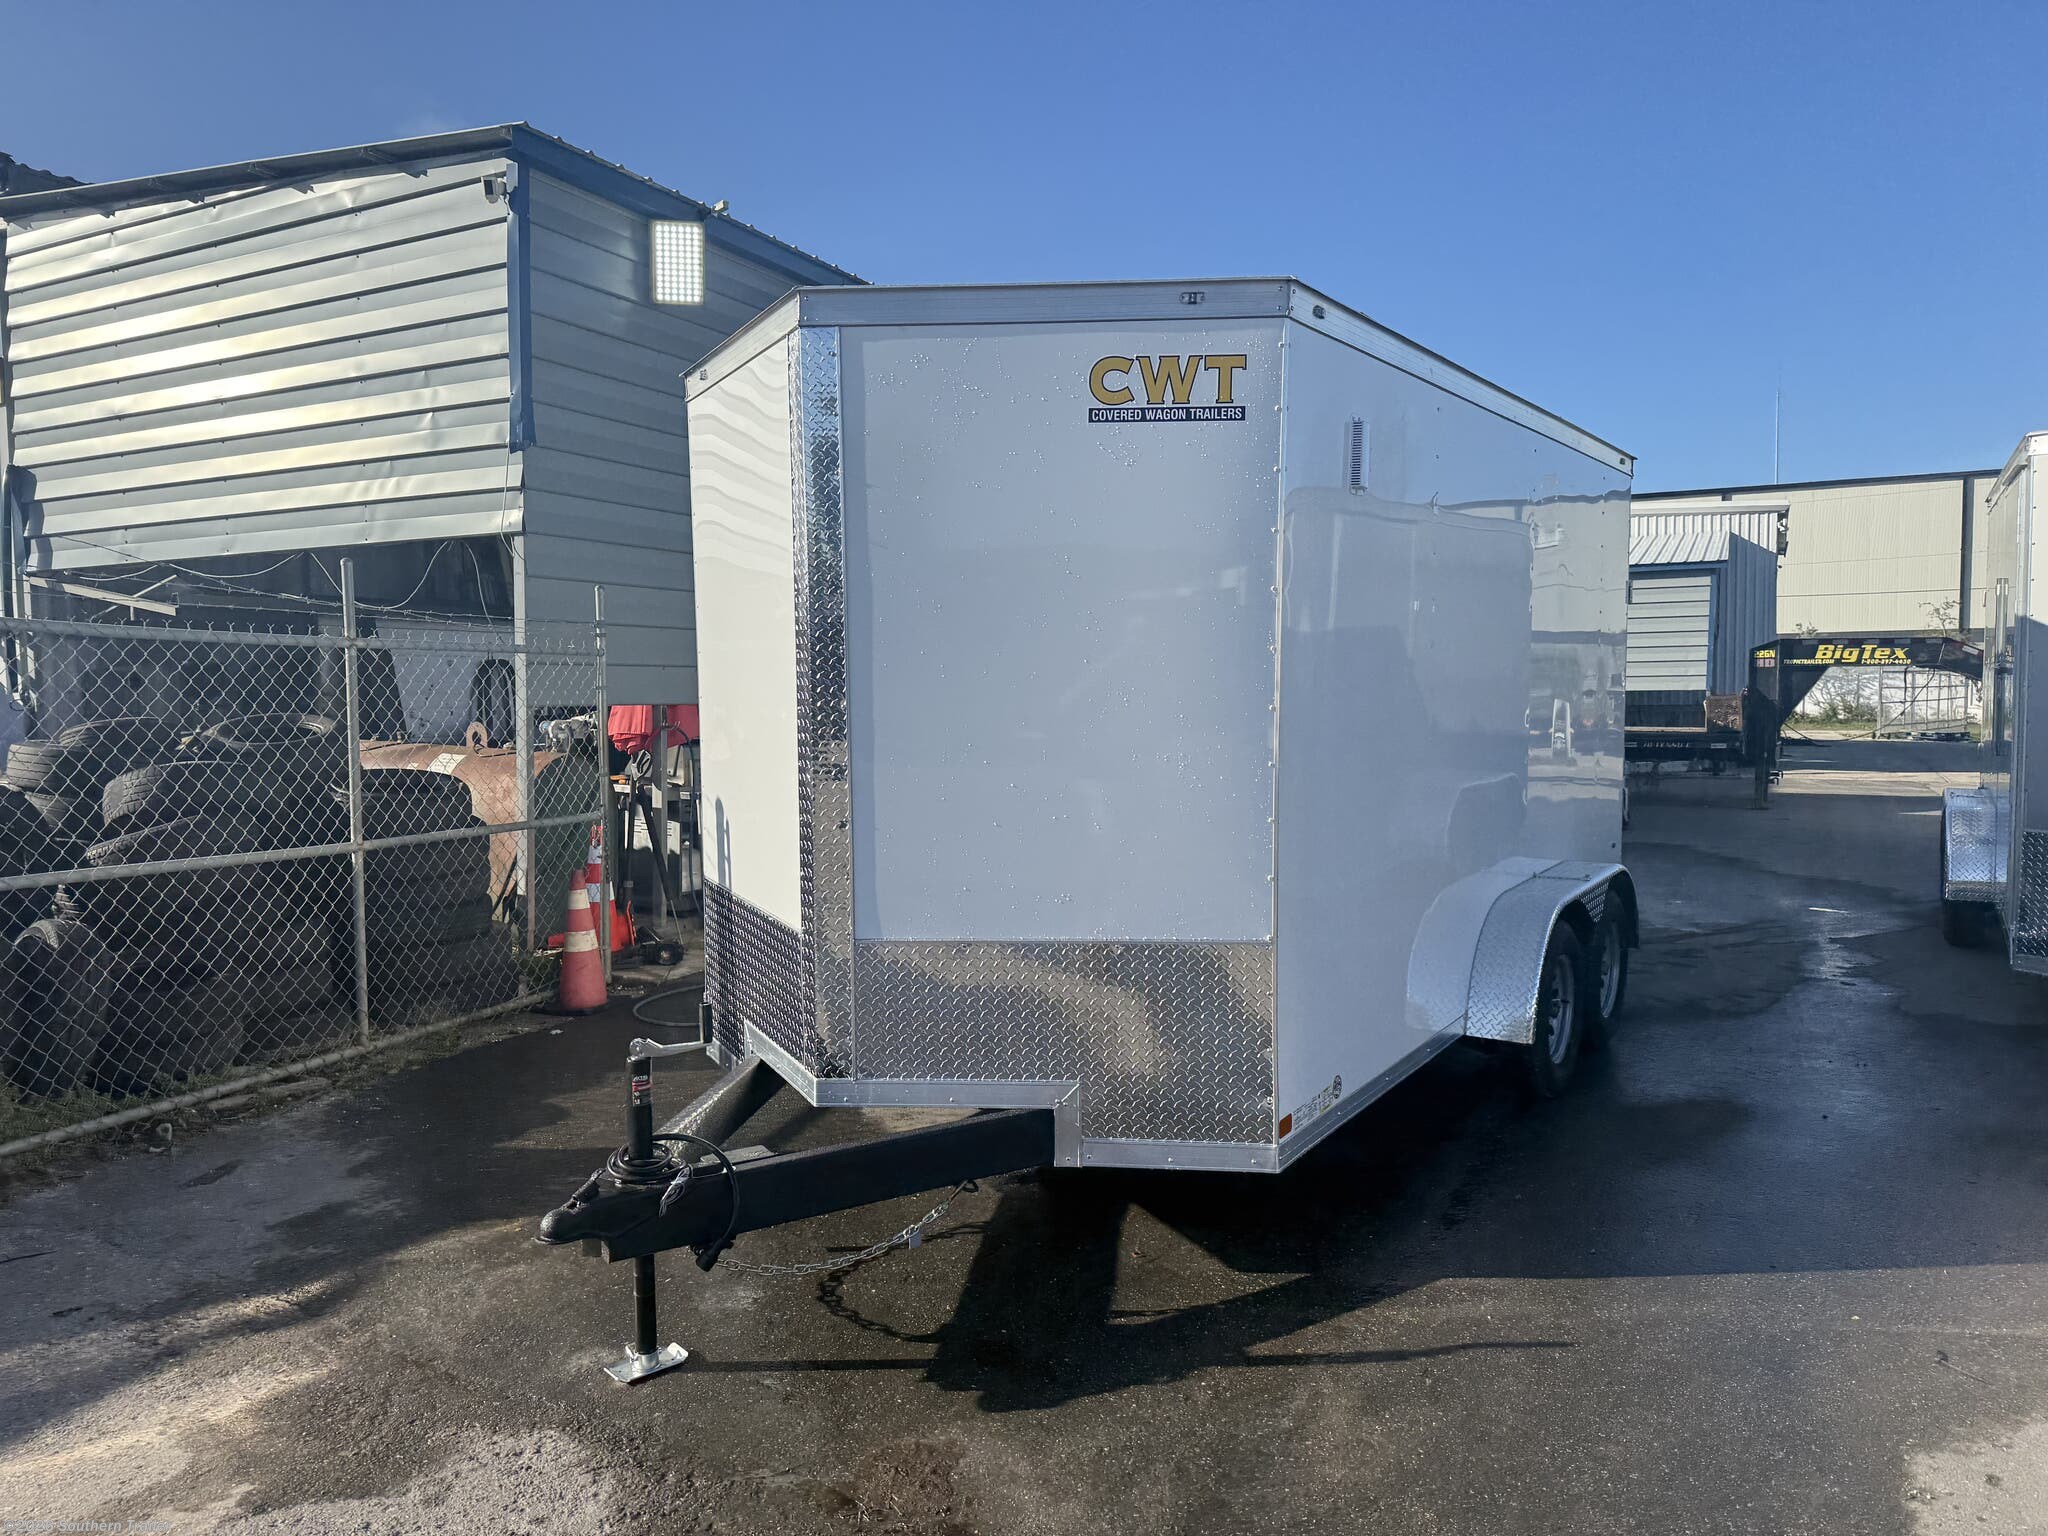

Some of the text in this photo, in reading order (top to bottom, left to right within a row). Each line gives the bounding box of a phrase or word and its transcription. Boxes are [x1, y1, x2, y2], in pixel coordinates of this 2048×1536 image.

[1089, 354, 1247, 405] CWT
[1092, 408, 1242, 421] COVERED WAGON TRAILERS
